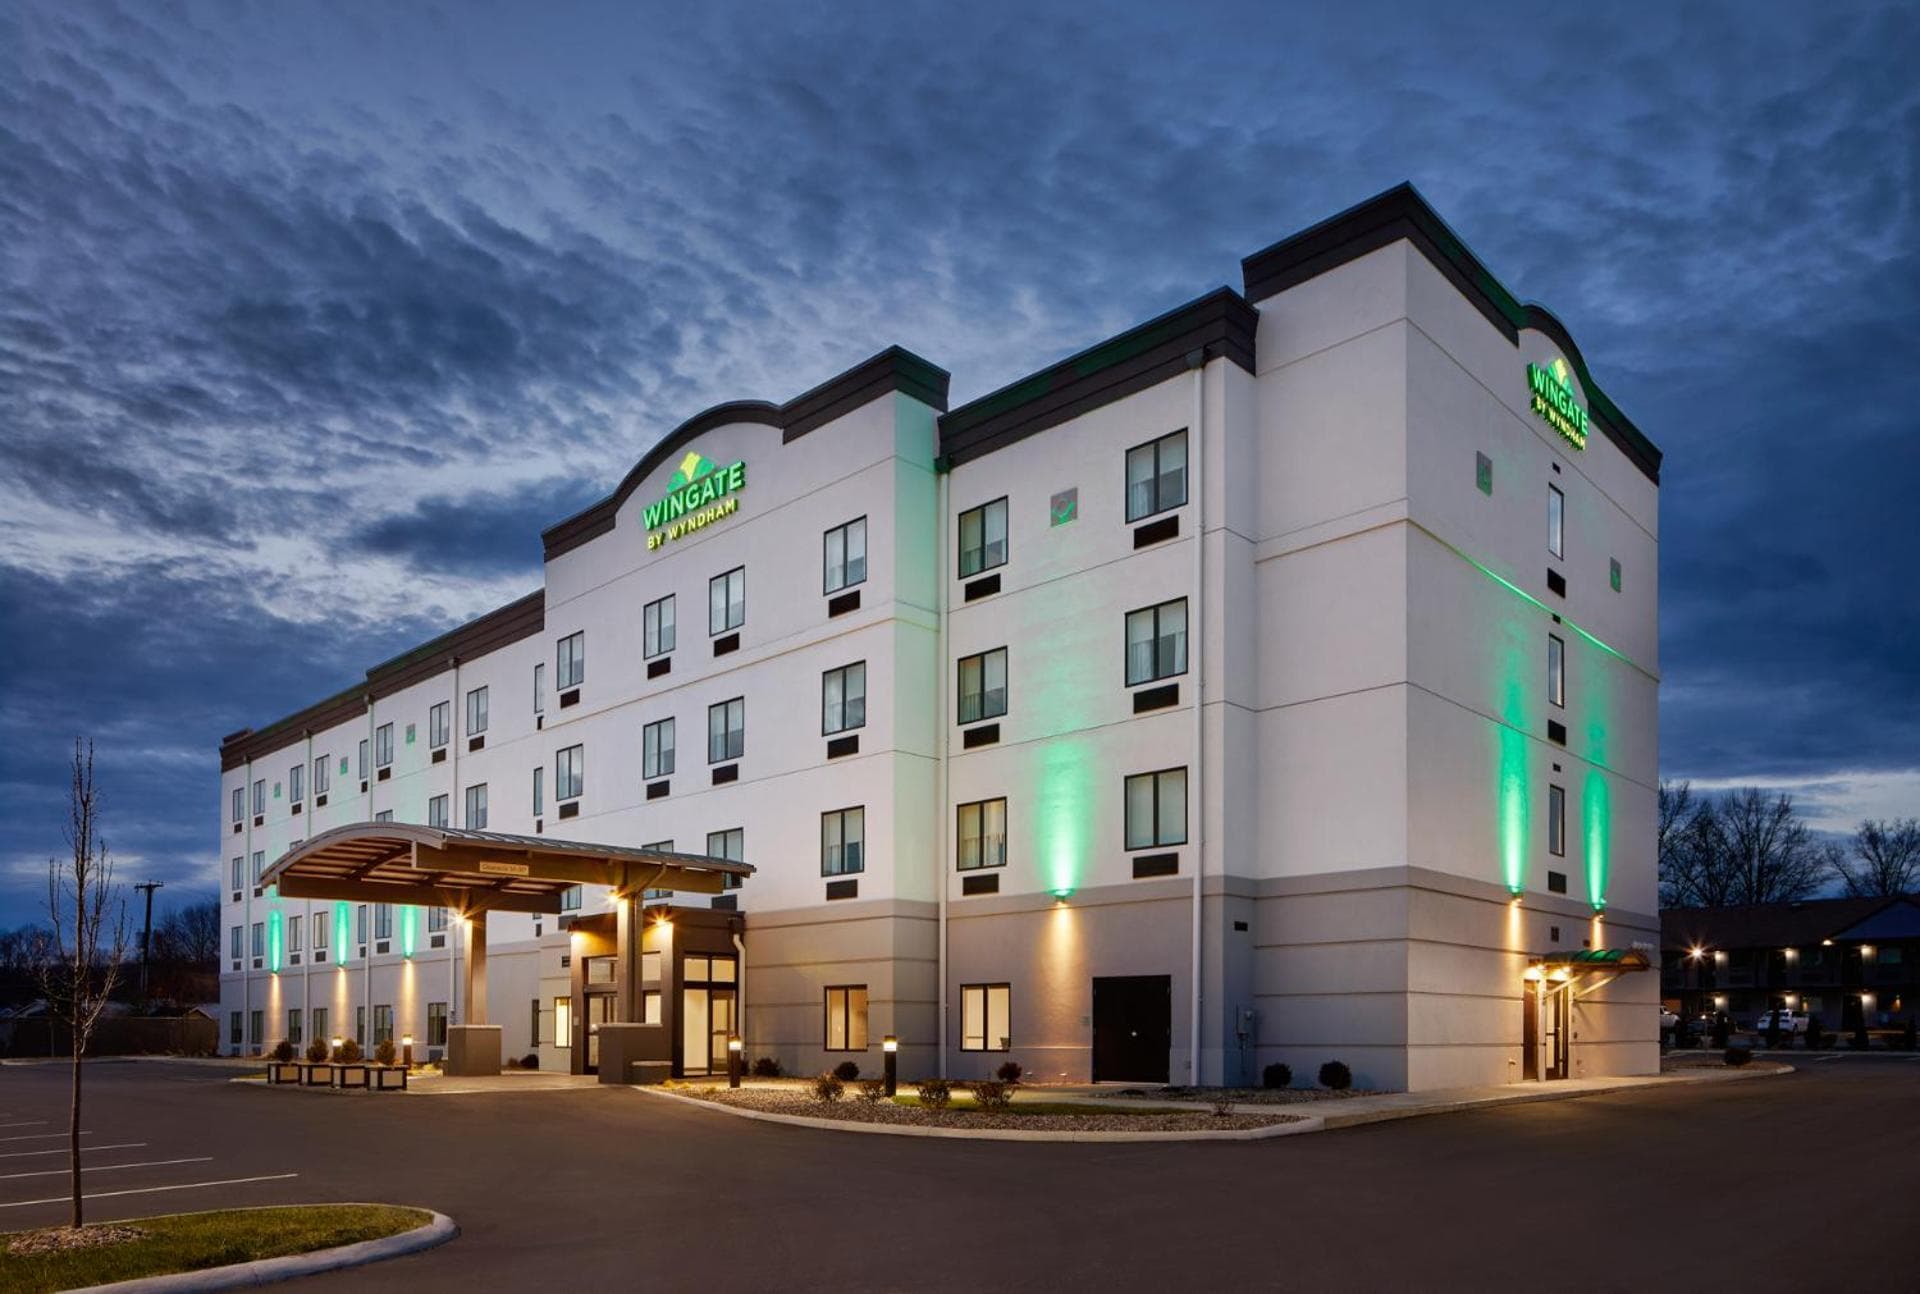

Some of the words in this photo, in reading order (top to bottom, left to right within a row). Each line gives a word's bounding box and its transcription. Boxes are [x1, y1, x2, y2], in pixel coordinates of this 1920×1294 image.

[1529, 362, 1588, 436] WINGATE
[642, 460, 745, 530] WINGATE
[648, 532, 665, 551] BY
[668, 498, 737, 540] WYNDHAM
